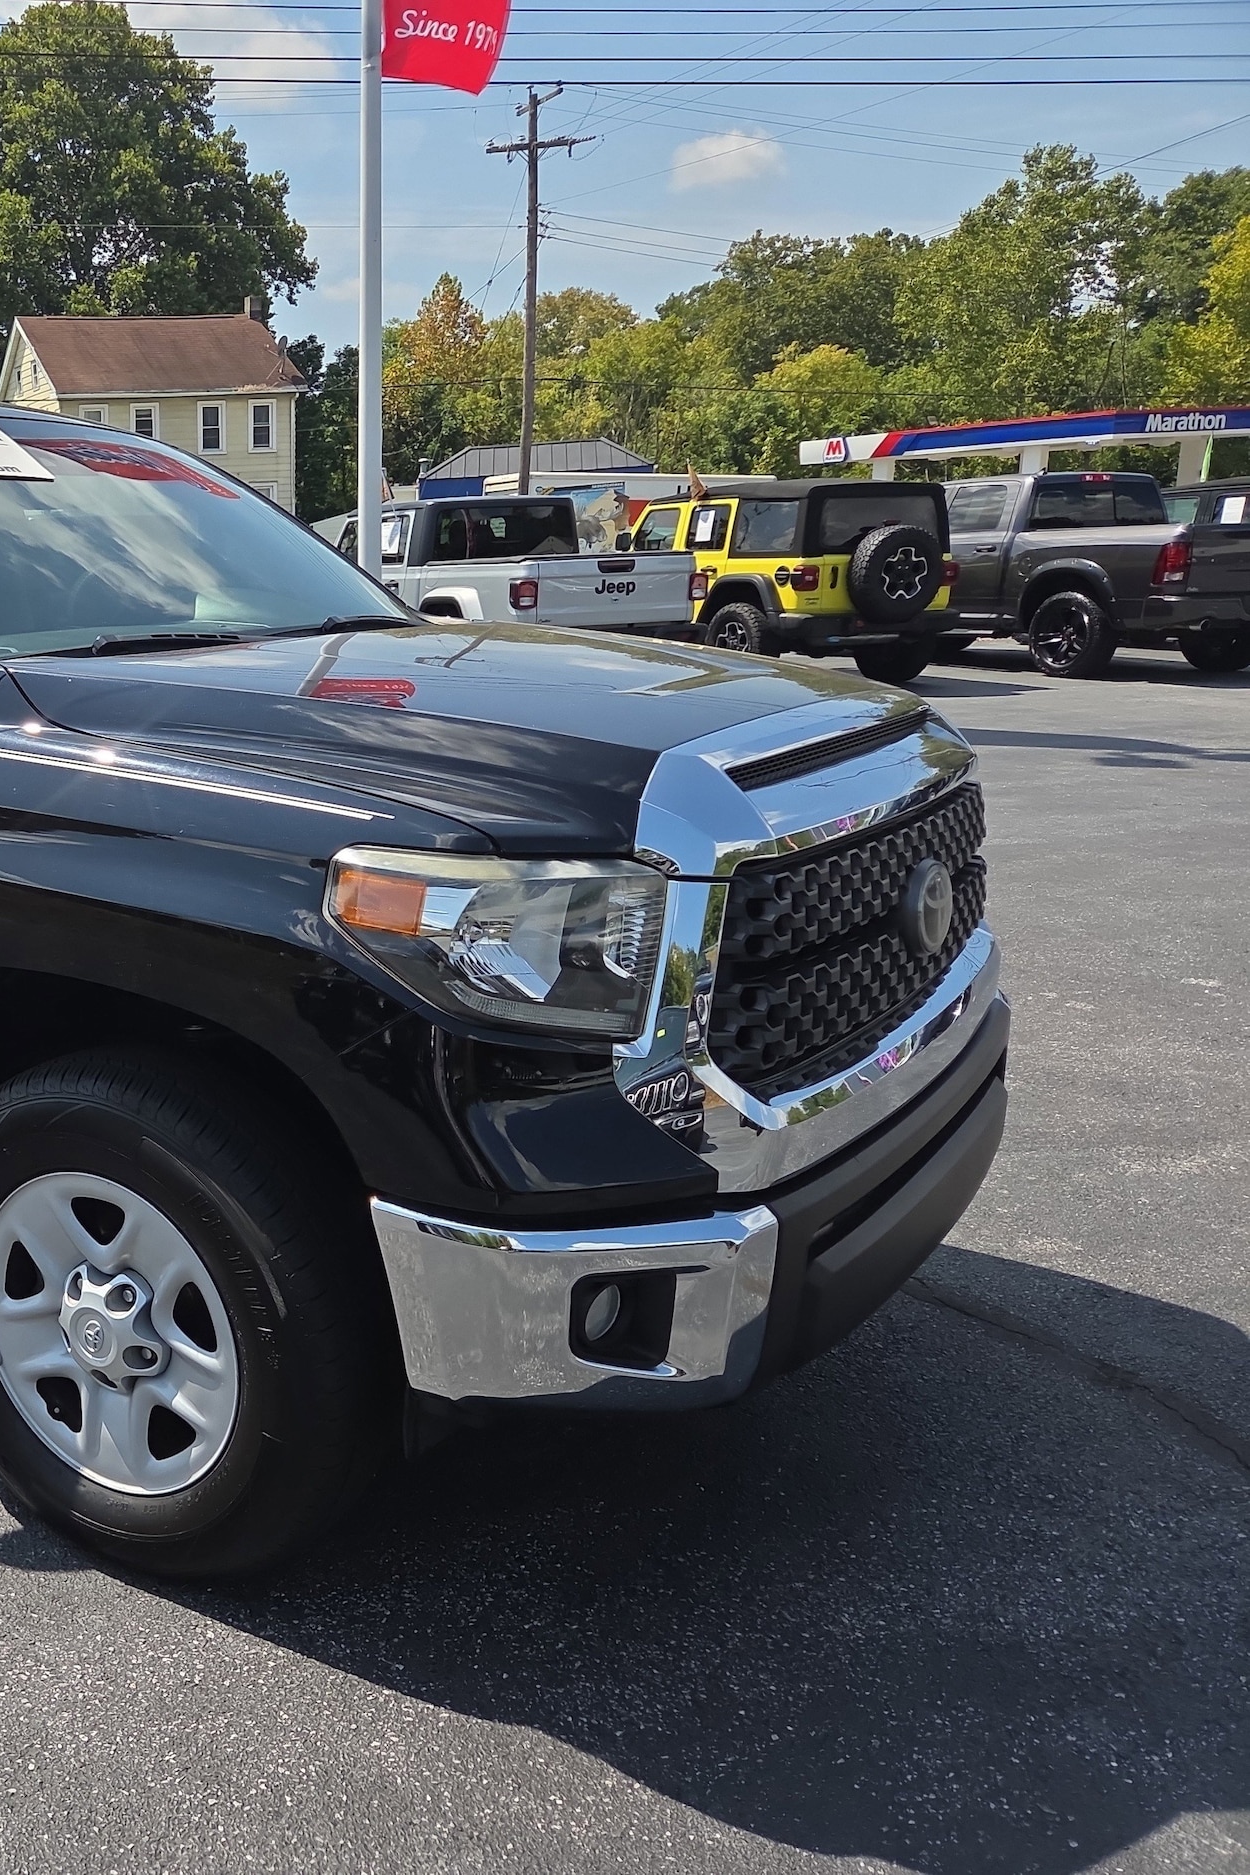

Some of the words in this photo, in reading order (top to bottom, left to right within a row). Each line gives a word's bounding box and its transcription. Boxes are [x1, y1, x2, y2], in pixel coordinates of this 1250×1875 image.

[394, 10, 459, 43] Since
[1145, 412, 1227, 432] Marathon
[826, 440, 843, 456] M
[595, 579, 636, 596] Jeep
